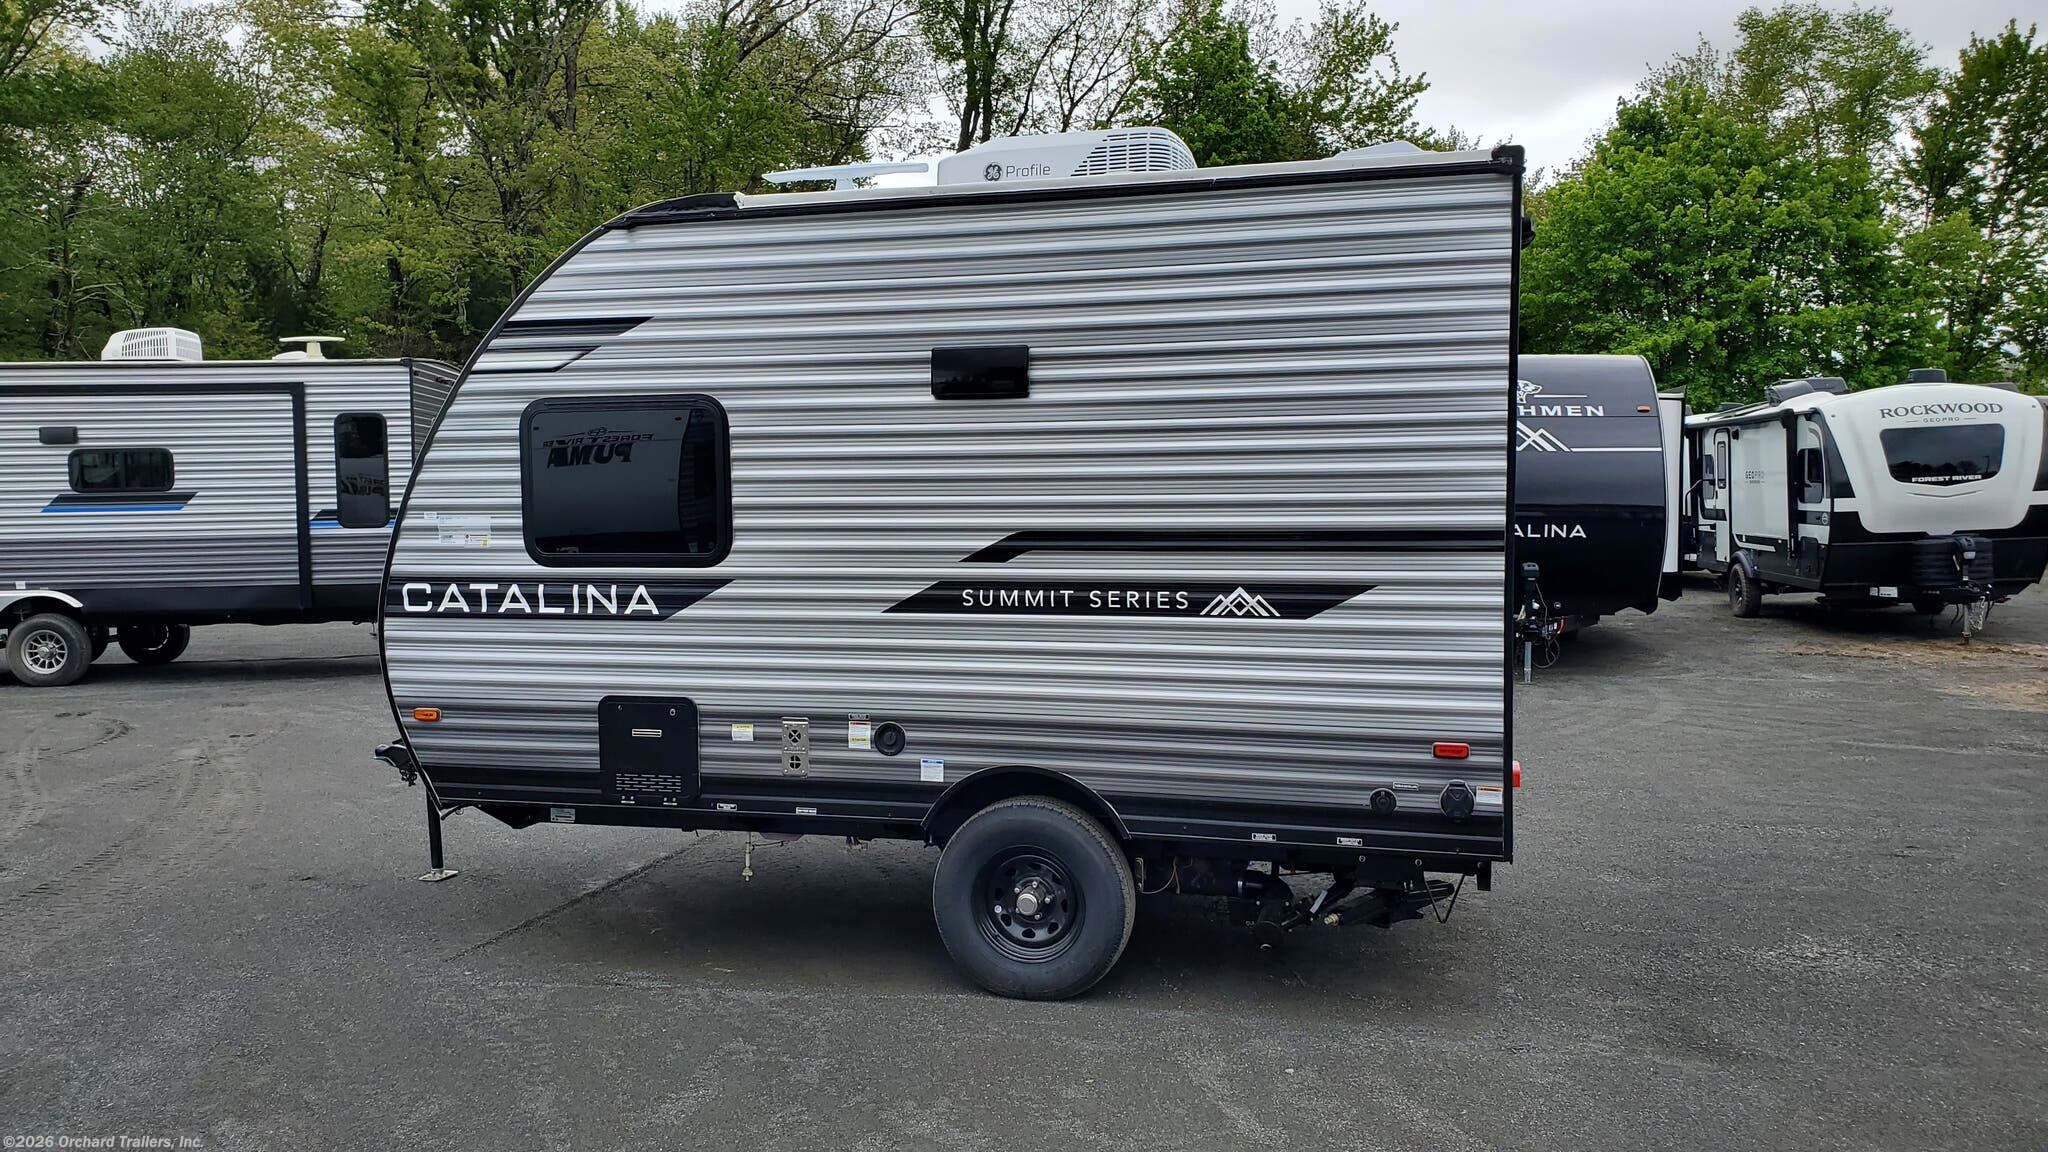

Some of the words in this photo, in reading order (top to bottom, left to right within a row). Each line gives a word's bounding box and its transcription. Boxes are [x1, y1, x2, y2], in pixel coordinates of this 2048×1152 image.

[1006, 164, 1051, 177] Profile
[1880, 403, 2003, 418] ROCKWOOD
[402, 583, 660, 615] CATALINA
[962, 589, 1075, 608] SUMMIT
[1089, 590, 1189, 609] SERIES
